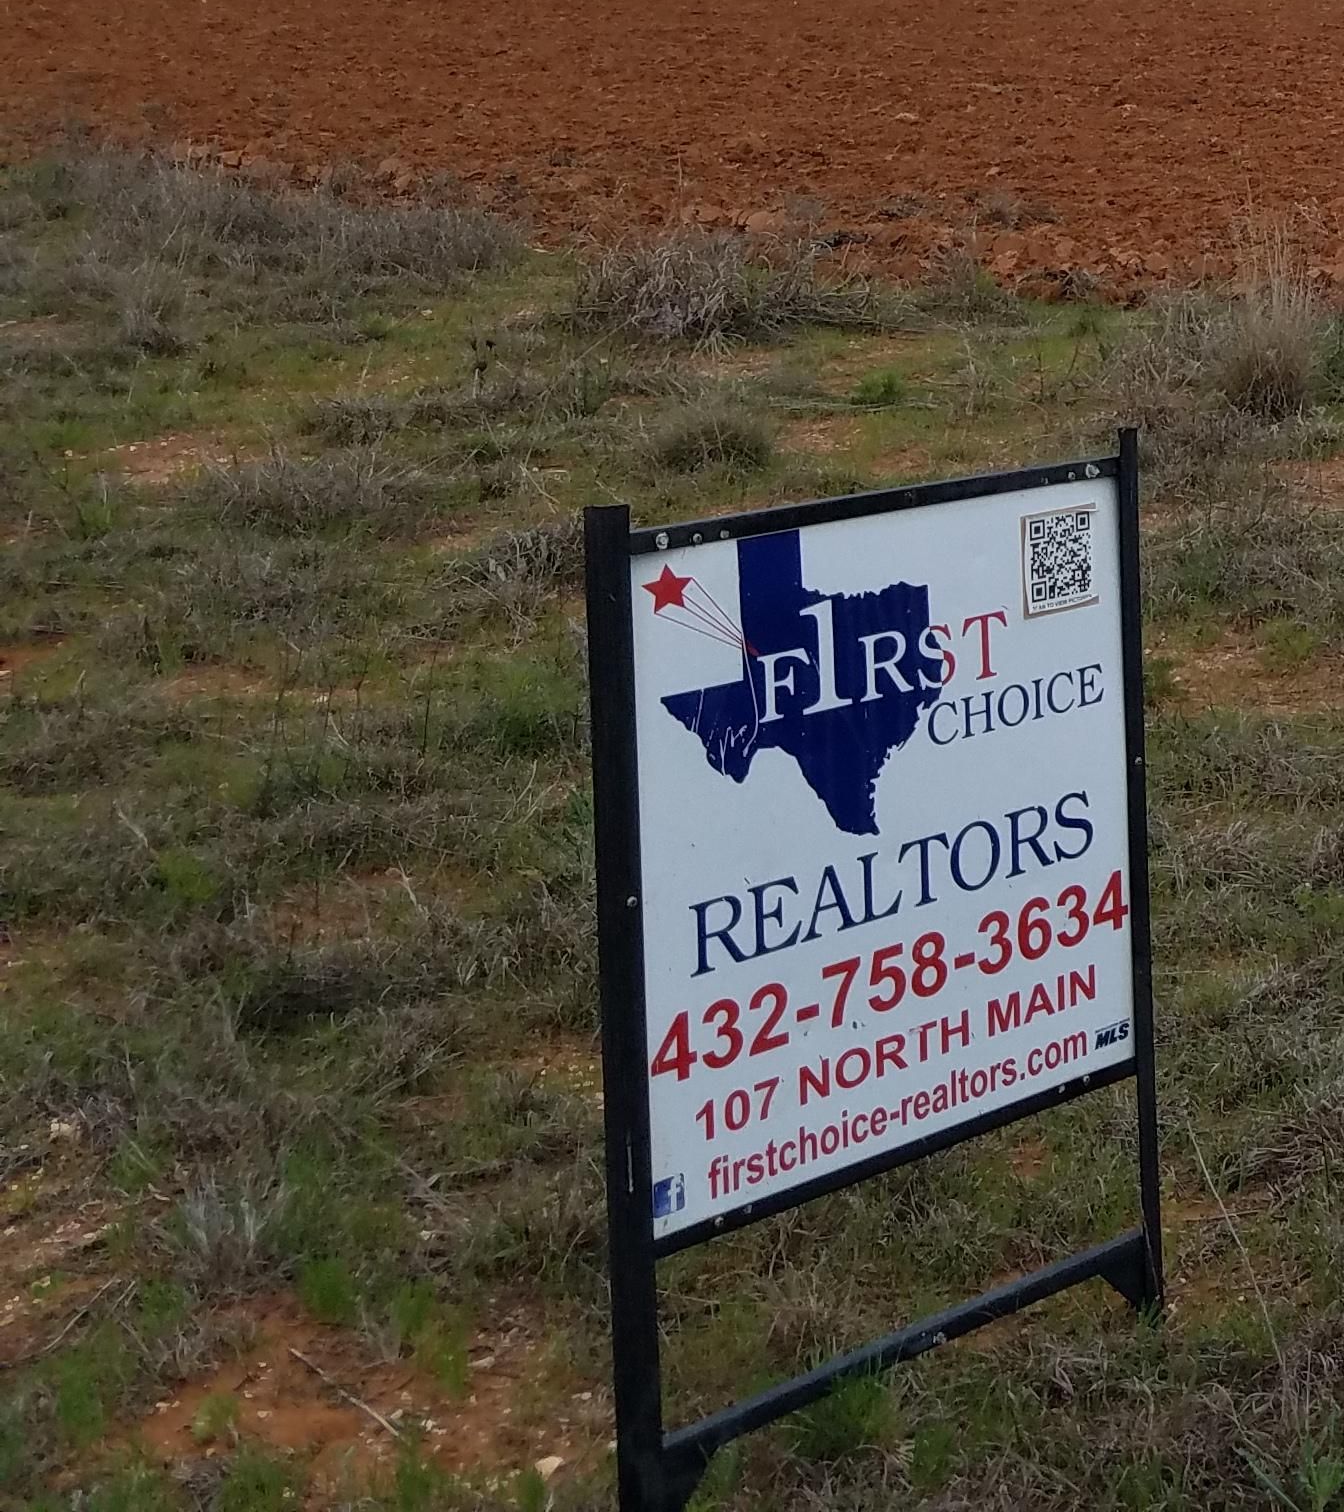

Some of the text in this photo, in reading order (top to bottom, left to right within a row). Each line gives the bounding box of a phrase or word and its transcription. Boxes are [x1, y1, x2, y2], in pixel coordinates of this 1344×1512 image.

[927, 663, 1106, 745] CHOICE
[689, 790, 1094, 978] REALTORS
[650, 870, 1129, 1083] 432-758-3634
[695, 964, 1097, 1140] 107 NORTH MAIN
[1094, 1022, 1130, 1050] MLS
[707, 1029, 1088, 1200] firstchoice-realtors.com
